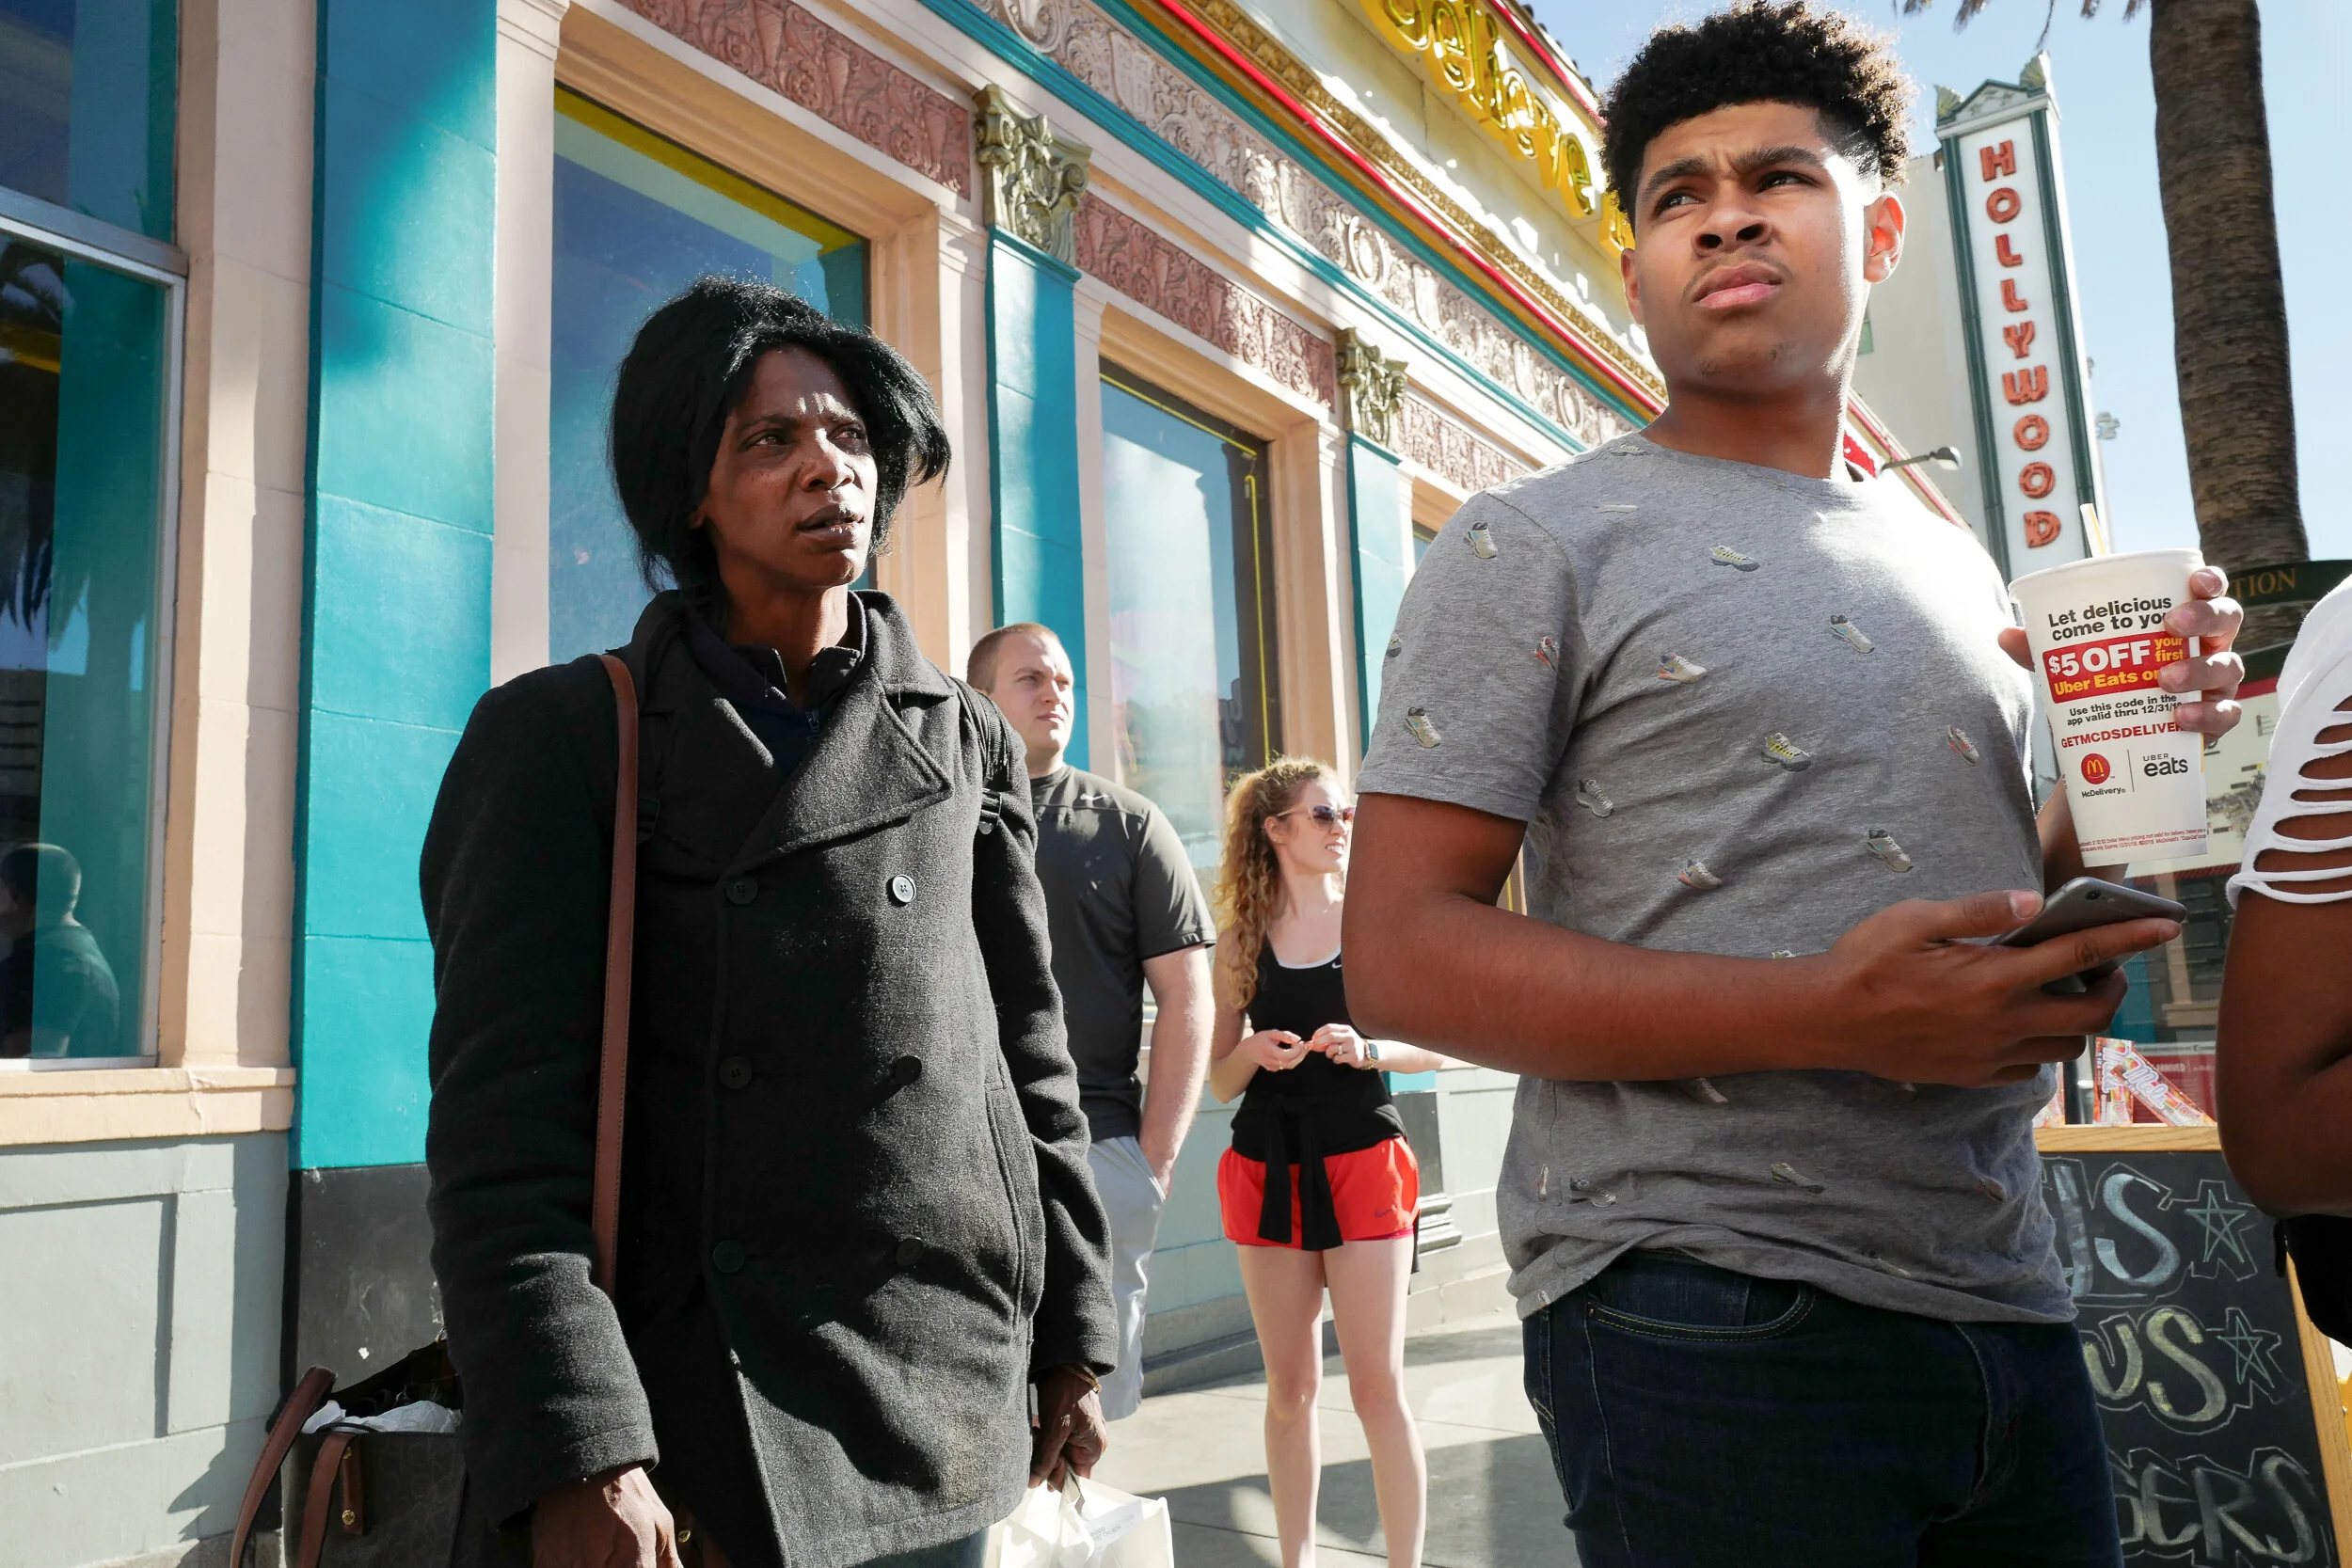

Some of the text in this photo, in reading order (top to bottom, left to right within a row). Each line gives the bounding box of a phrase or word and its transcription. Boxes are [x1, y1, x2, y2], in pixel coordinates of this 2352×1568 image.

[1979, 138, 2062, 549] HOLLYWOOD
[2229, 567, 2296, 599] TION
[2048, 597, 2172, 627] Let delicious
[2052, 612, 2166, 641] come to yo
[2153, 637, 2183, 650] your
[2155, 648, 2184, 662] first
[2048, 640, 2151, 676] $5 OFF
[2054, 669, 2159, 695] Uber Eats or
[2067, 702, 2183, 726] app valid thru 12/31/1
[2069, 693, 2177, 718] Use this code in the
[2143, 752, 2169, 762] UBER
[2143, 757, 2188, 777] eats
